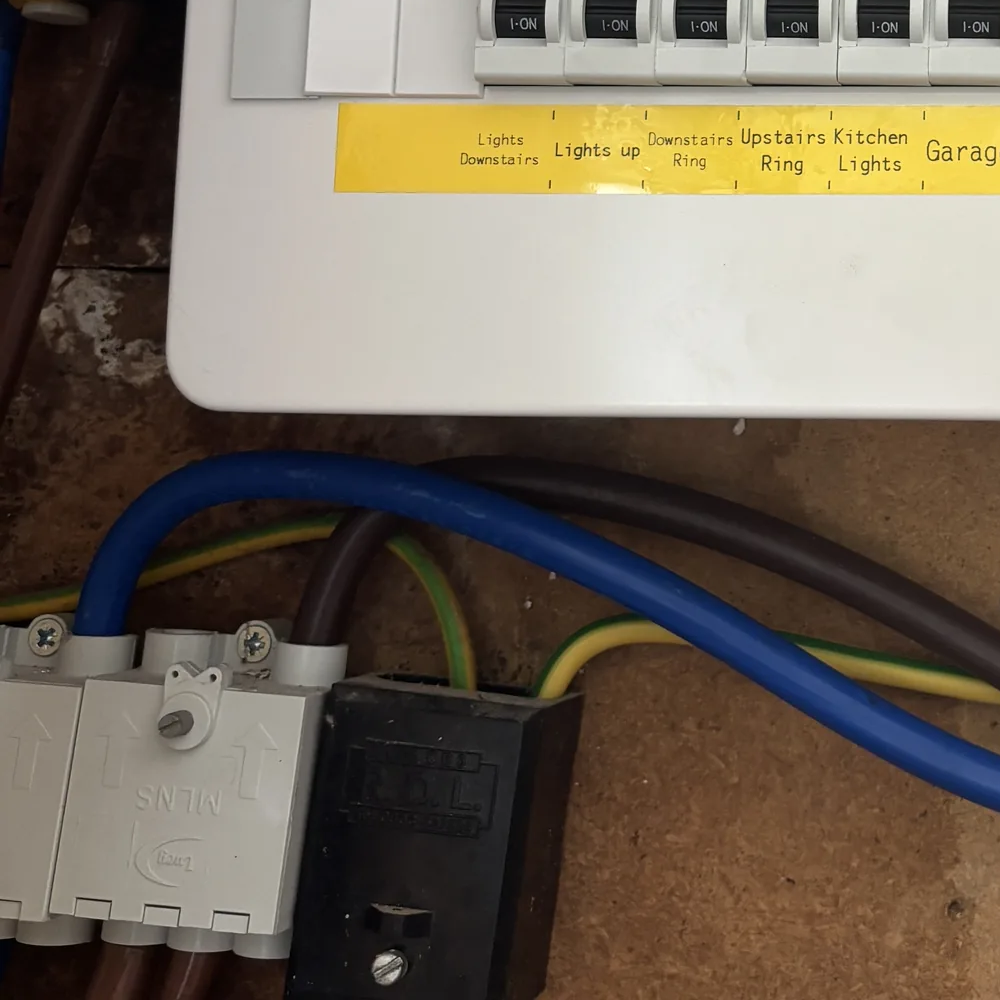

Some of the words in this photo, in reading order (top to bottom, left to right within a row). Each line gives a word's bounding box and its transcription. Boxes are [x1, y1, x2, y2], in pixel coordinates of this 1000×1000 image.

[478, 133, 524, 149] Lights
[648, 132, 734, 148] Downstairs
[741, 128, 826, 149] Upstairs
[833, 128, 908, 145] Kitchen
[460, 152, 539, 167] Downstairs
[555, 141, 611, 162] Lights
[621, 145, 641, 162] up
[673, 153, 707, 170] Ring
[761, 155, 804, 176] Ring
[839, 155, 902, 175] Lights
